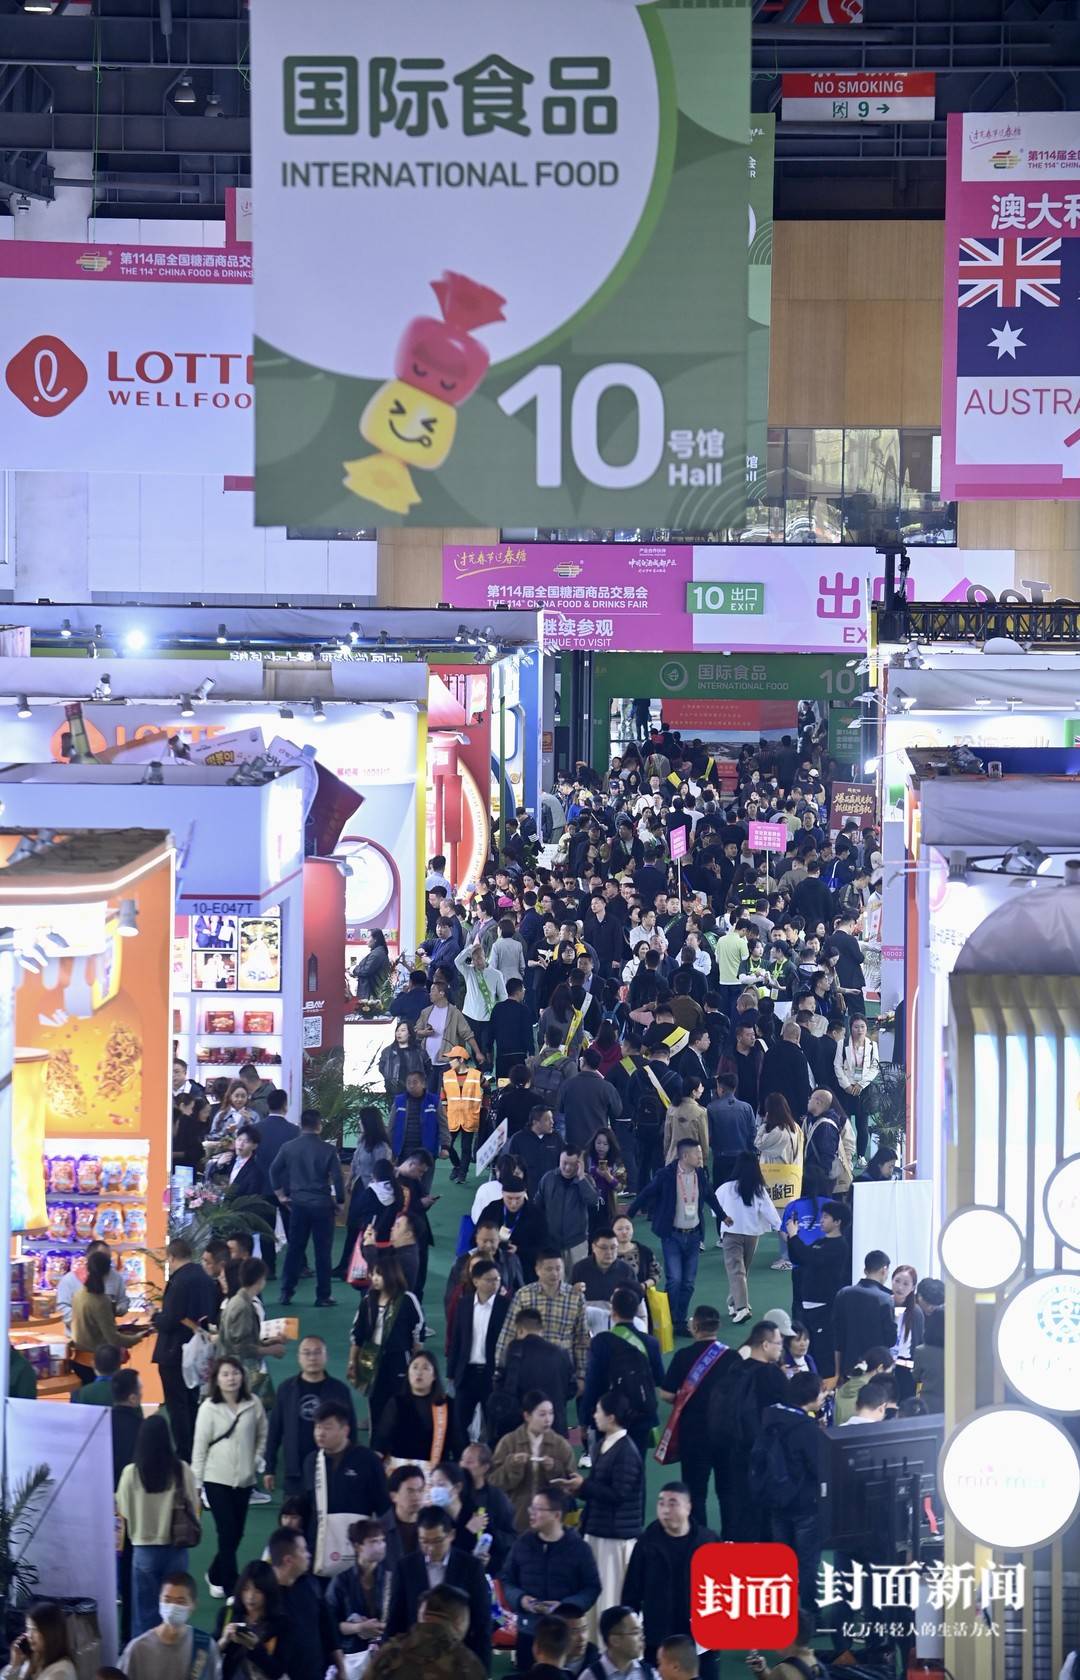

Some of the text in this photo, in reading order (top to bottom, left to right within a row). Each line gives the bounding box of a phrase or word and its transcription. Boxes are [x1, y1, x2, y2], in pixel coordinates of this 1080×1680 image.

[283, 53, 618, 138] 国际食品
[814, 81, 904, 94] NO SMOKING
[858, 101, 870, 118] 9
[1028, 150, 1080, 161] 第114届全
[282, 161, 619, 188] INTERNATIONAL FOOD
[120, 267, 138, 276] THE
[158, 268, 186, 277] CHINA
[188, 269, 212, 277] FOOD
[108, 390, 252, 409] WELLFOO
[497, 362, 665, 489] 10
[668, 428, 725, 459] 号馆
[668, 462, 722, 487] Hall
[487, 584, 648, 599] 第114届全国糖酒商品交易会
[693, 586, 725, 610] 10
[730, 587, 758, 602] 出口
[527, 600, 556, 608] CHNA
[557, 600, 582, 608] FOOD
[585, 600, 591, 608] &
[593, 600, 625, 608] DRINKS
[627, 600, 648, 608] FAIR
[730, 603, 755, 612] EXIT
[574, 638, 586, 647] TO
[587, 638, 612, 647] VISIT
[697, 664, 767, 681] 国际食品
[697, 682, 789, 690] INTERNATIONAL FOOD
[819, 669, 856, 694] 10
[192, 902, 254, 914] 10-E047T
